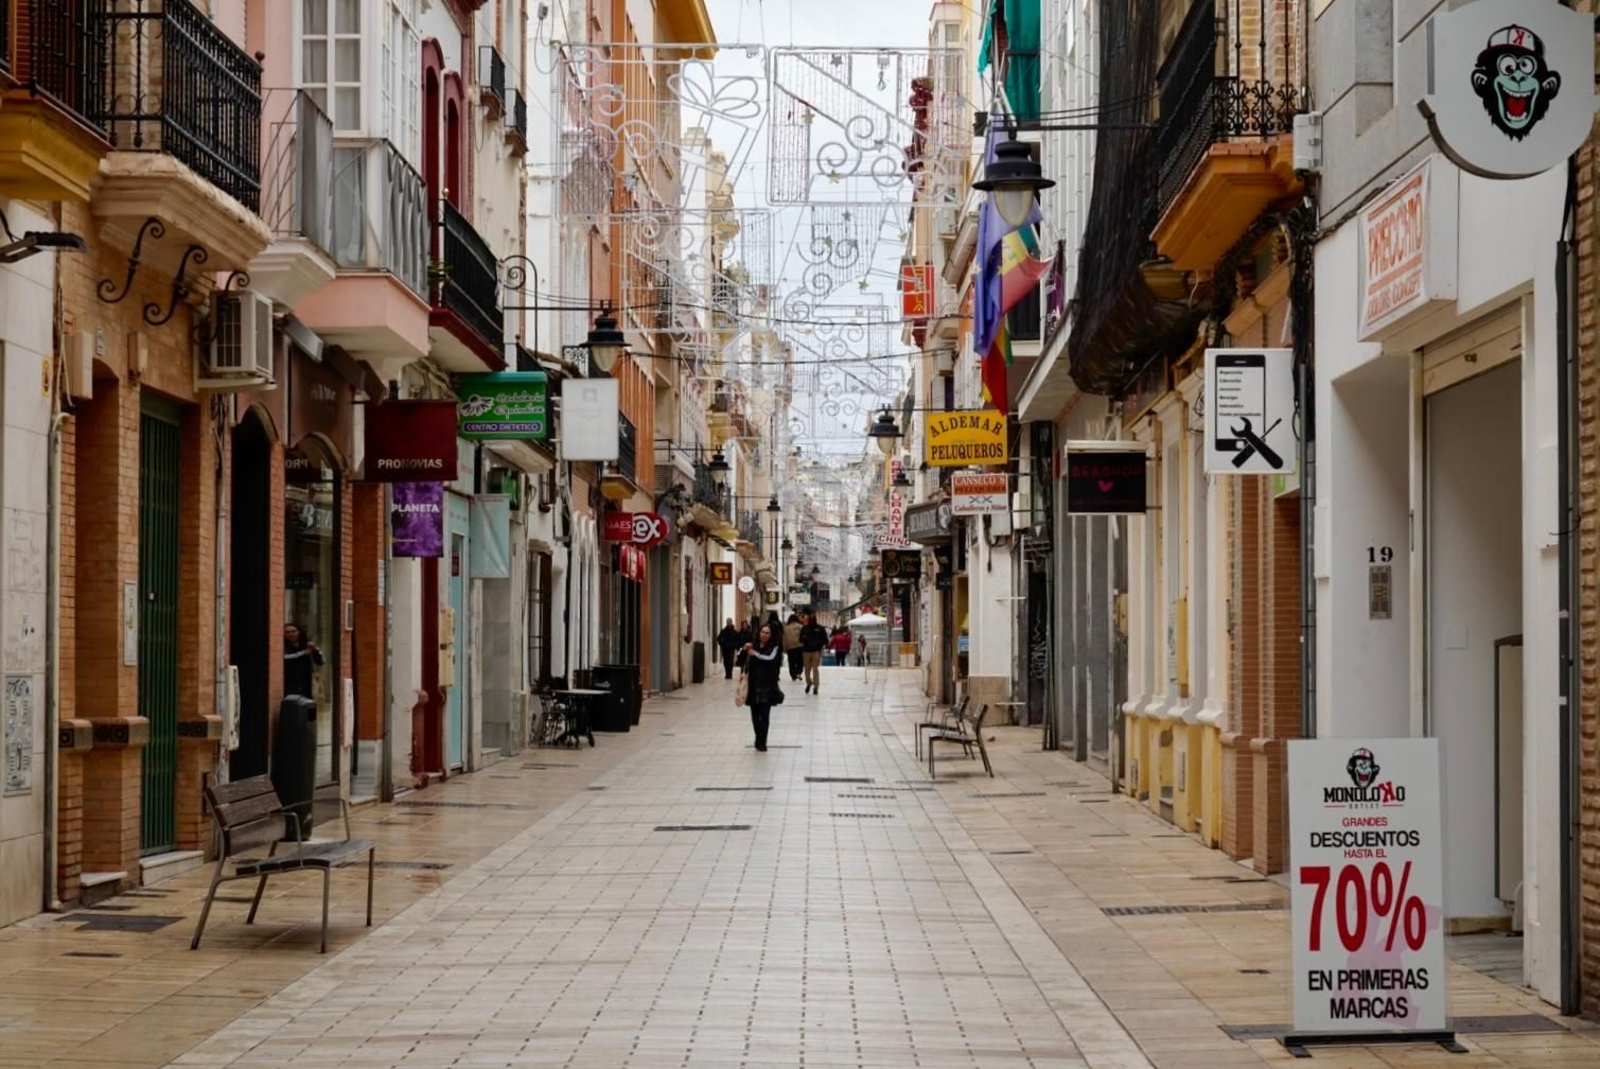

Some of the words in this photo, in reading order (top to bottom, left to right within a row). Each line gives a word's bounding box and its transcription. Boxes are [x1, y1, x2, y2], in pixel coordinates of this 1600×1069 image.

[466, 423, 498, 431] CENTRO
[930, 415, 1003, 438] ALDEMAR
[931, 442, 1003, 460] PELUQUEROS
[378, 459, 443, 469] PRONOVIAS
[391, 503, 440, 513] PLANETA
[878, 535, 912, 547] CHINO
[1367, 546, 1393, 562] 19
[1323, 781, 1405, 803] MONOLOKO
[1342, 817, 1388, 827] GRANDES
[1310, 830, 1420, 848] DESCUENTOS
[1344, 849, 1373, 858] HASTA
[1376, 849, 1387, 857] EL
[1300, 861, 1426, 951] 70%
[1308, 970, 1333, 991] EN
[1337, 968, 1429, 990] PRIMERAS
[1330, 997, 1408, 1019] MARCAS
